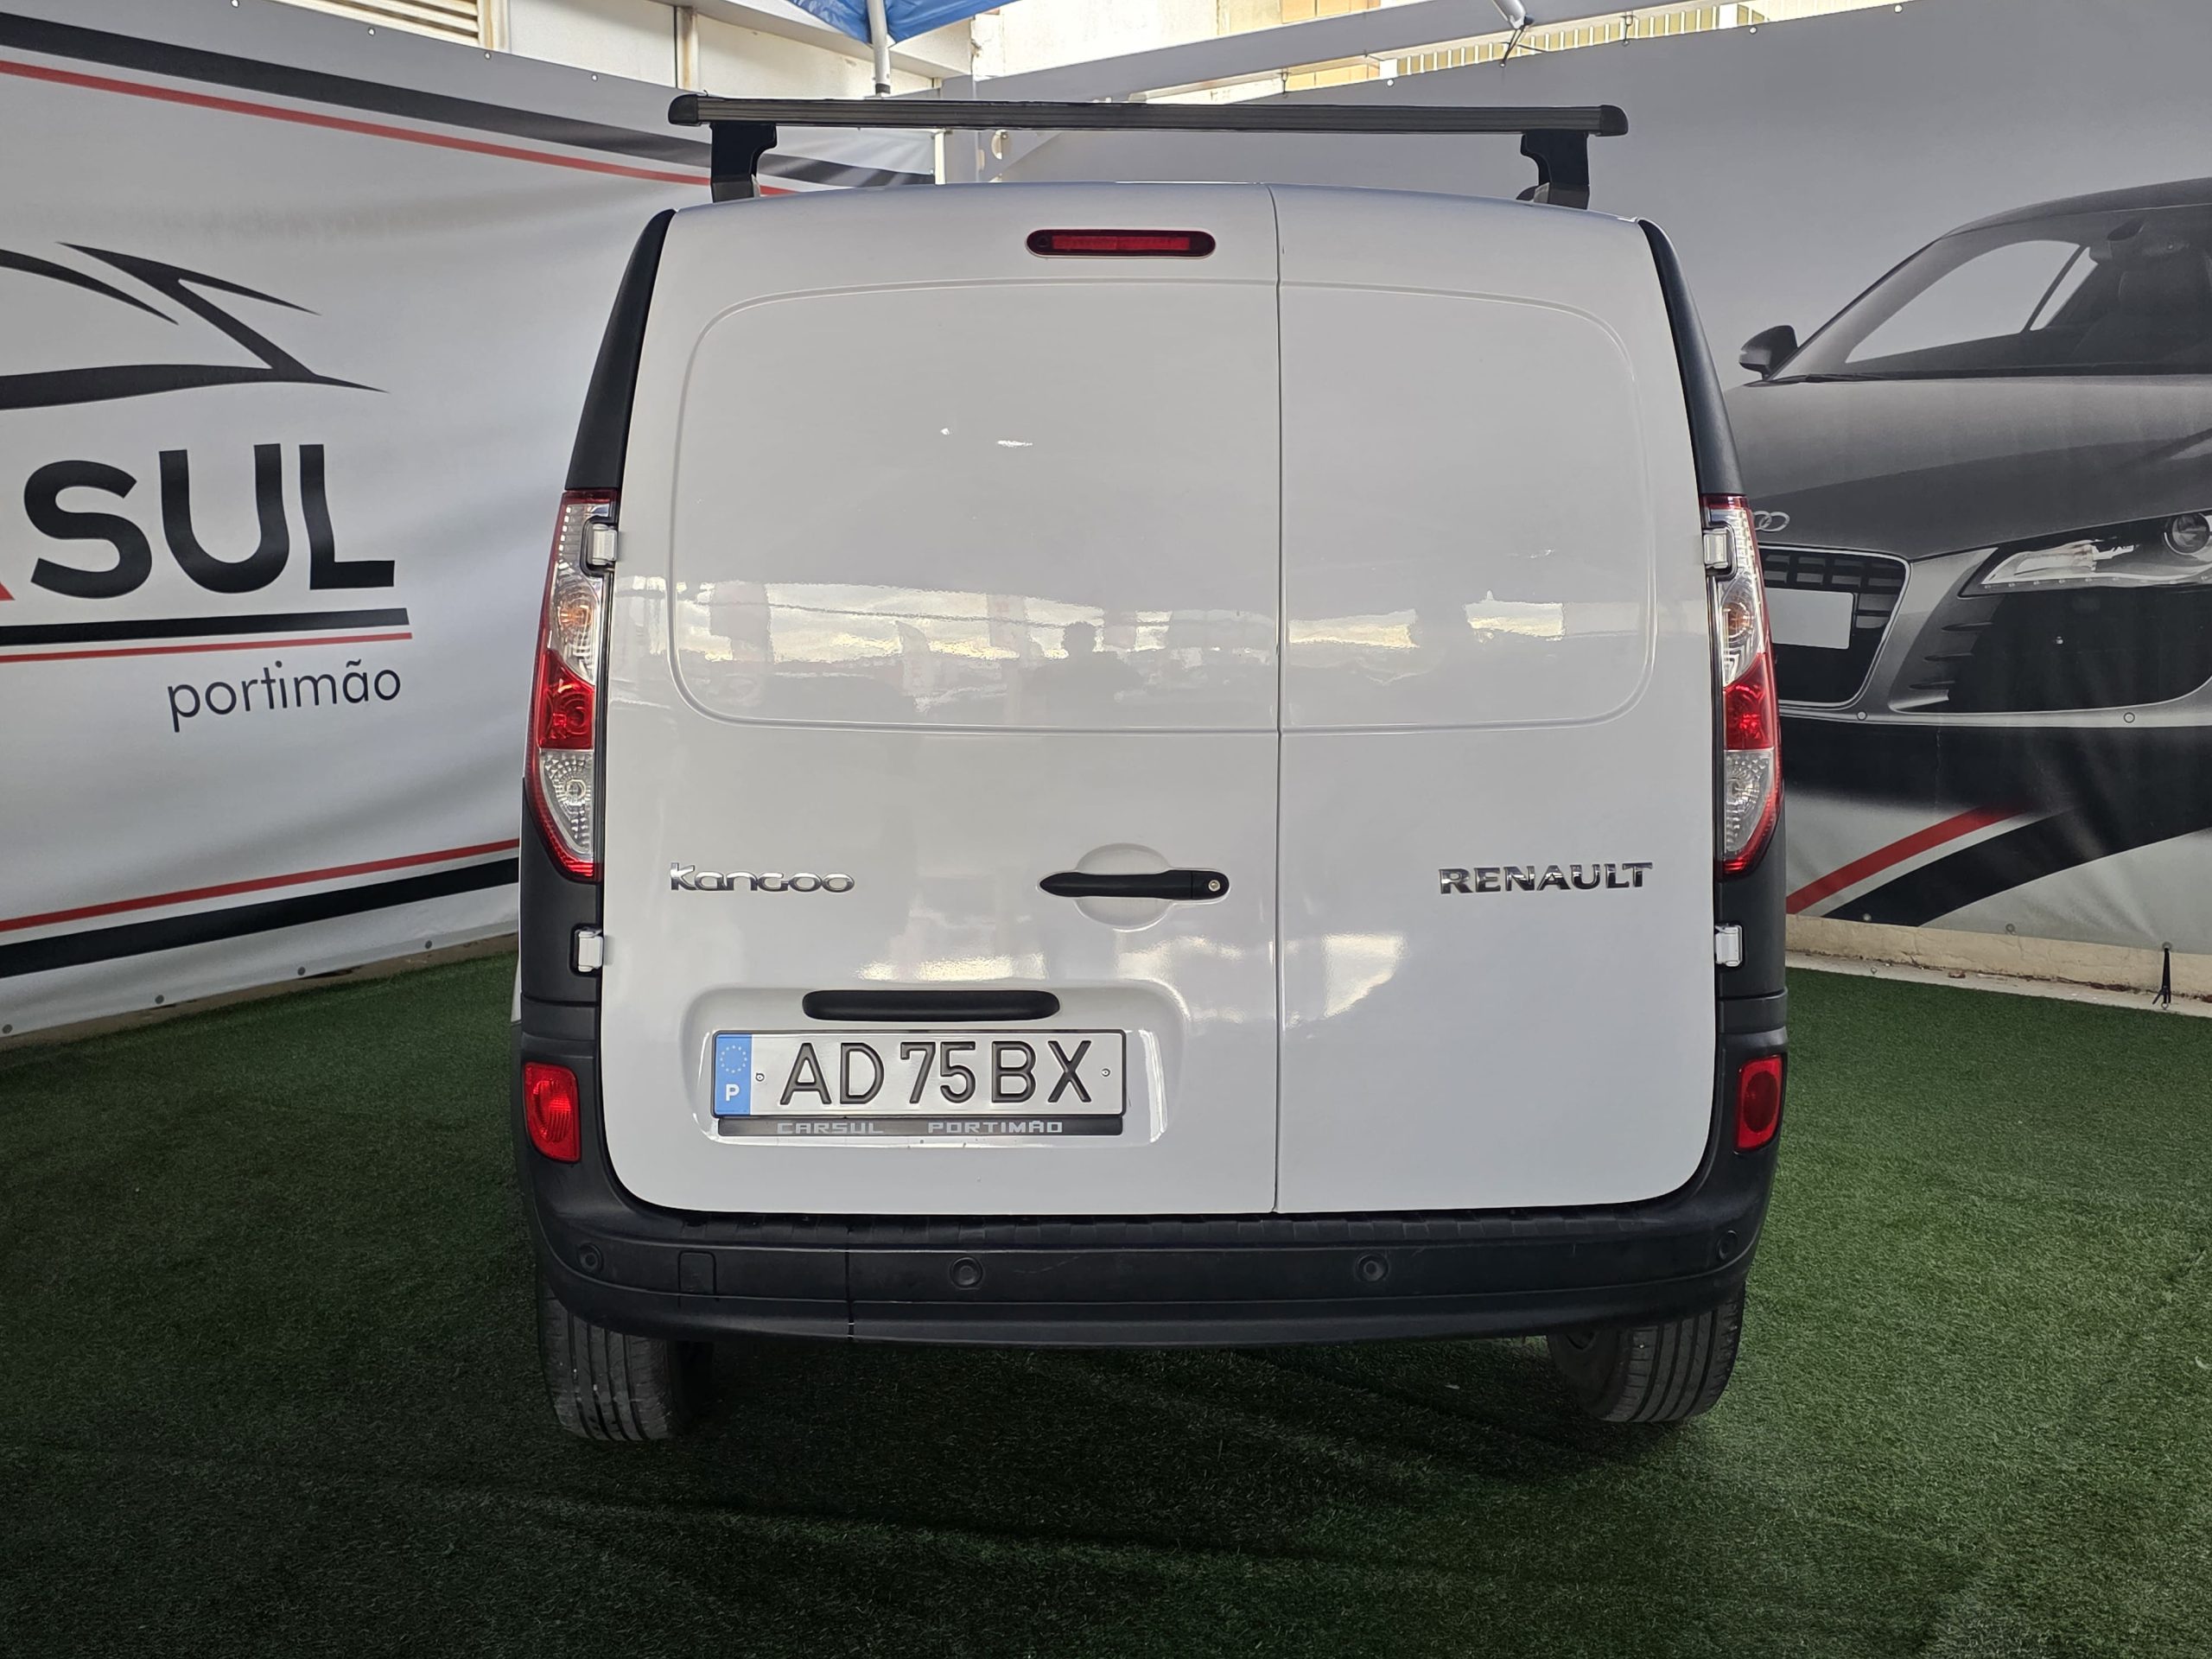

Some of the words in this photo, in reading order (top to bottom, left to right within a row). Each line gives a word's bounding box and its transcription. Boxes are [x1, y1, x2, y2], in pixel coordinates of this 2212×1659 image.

[0, 443, 395, 600] SUL
[168, 658, 401, 734] portimão
[1439, 861, 1653, 894] RENAULT
[726, 1084, 740, 1102] P
[777, 1122, 884, 1135] CARSUL
